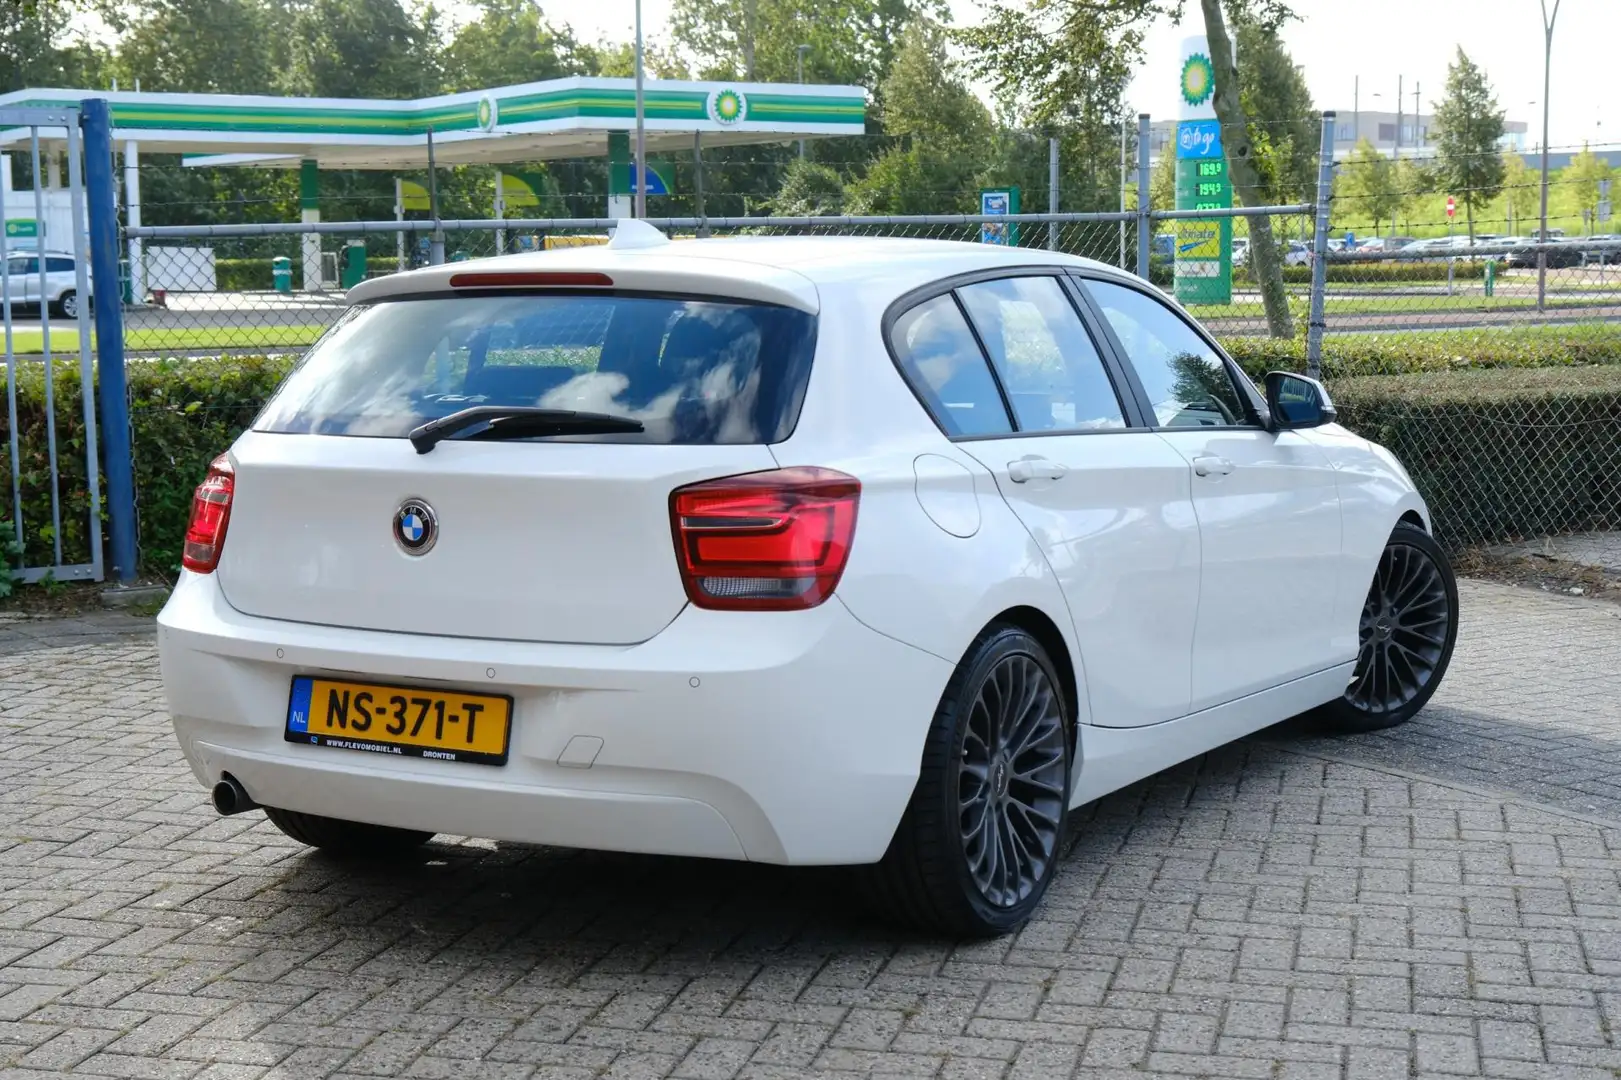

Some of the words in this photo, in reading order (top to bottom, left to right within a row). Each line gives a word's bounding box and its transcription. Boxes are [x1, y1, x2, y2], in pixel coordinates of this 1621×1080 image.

[1199, 163, 1221, 176] 169.9
[292, 711, 306, 724] NL
[326, 689, 484, 744] NS-371-T
[326, 739, 403, 754] WWW.FLEVOMOBIEL.NL
[422, 750, 456, 761] DRONTEN
